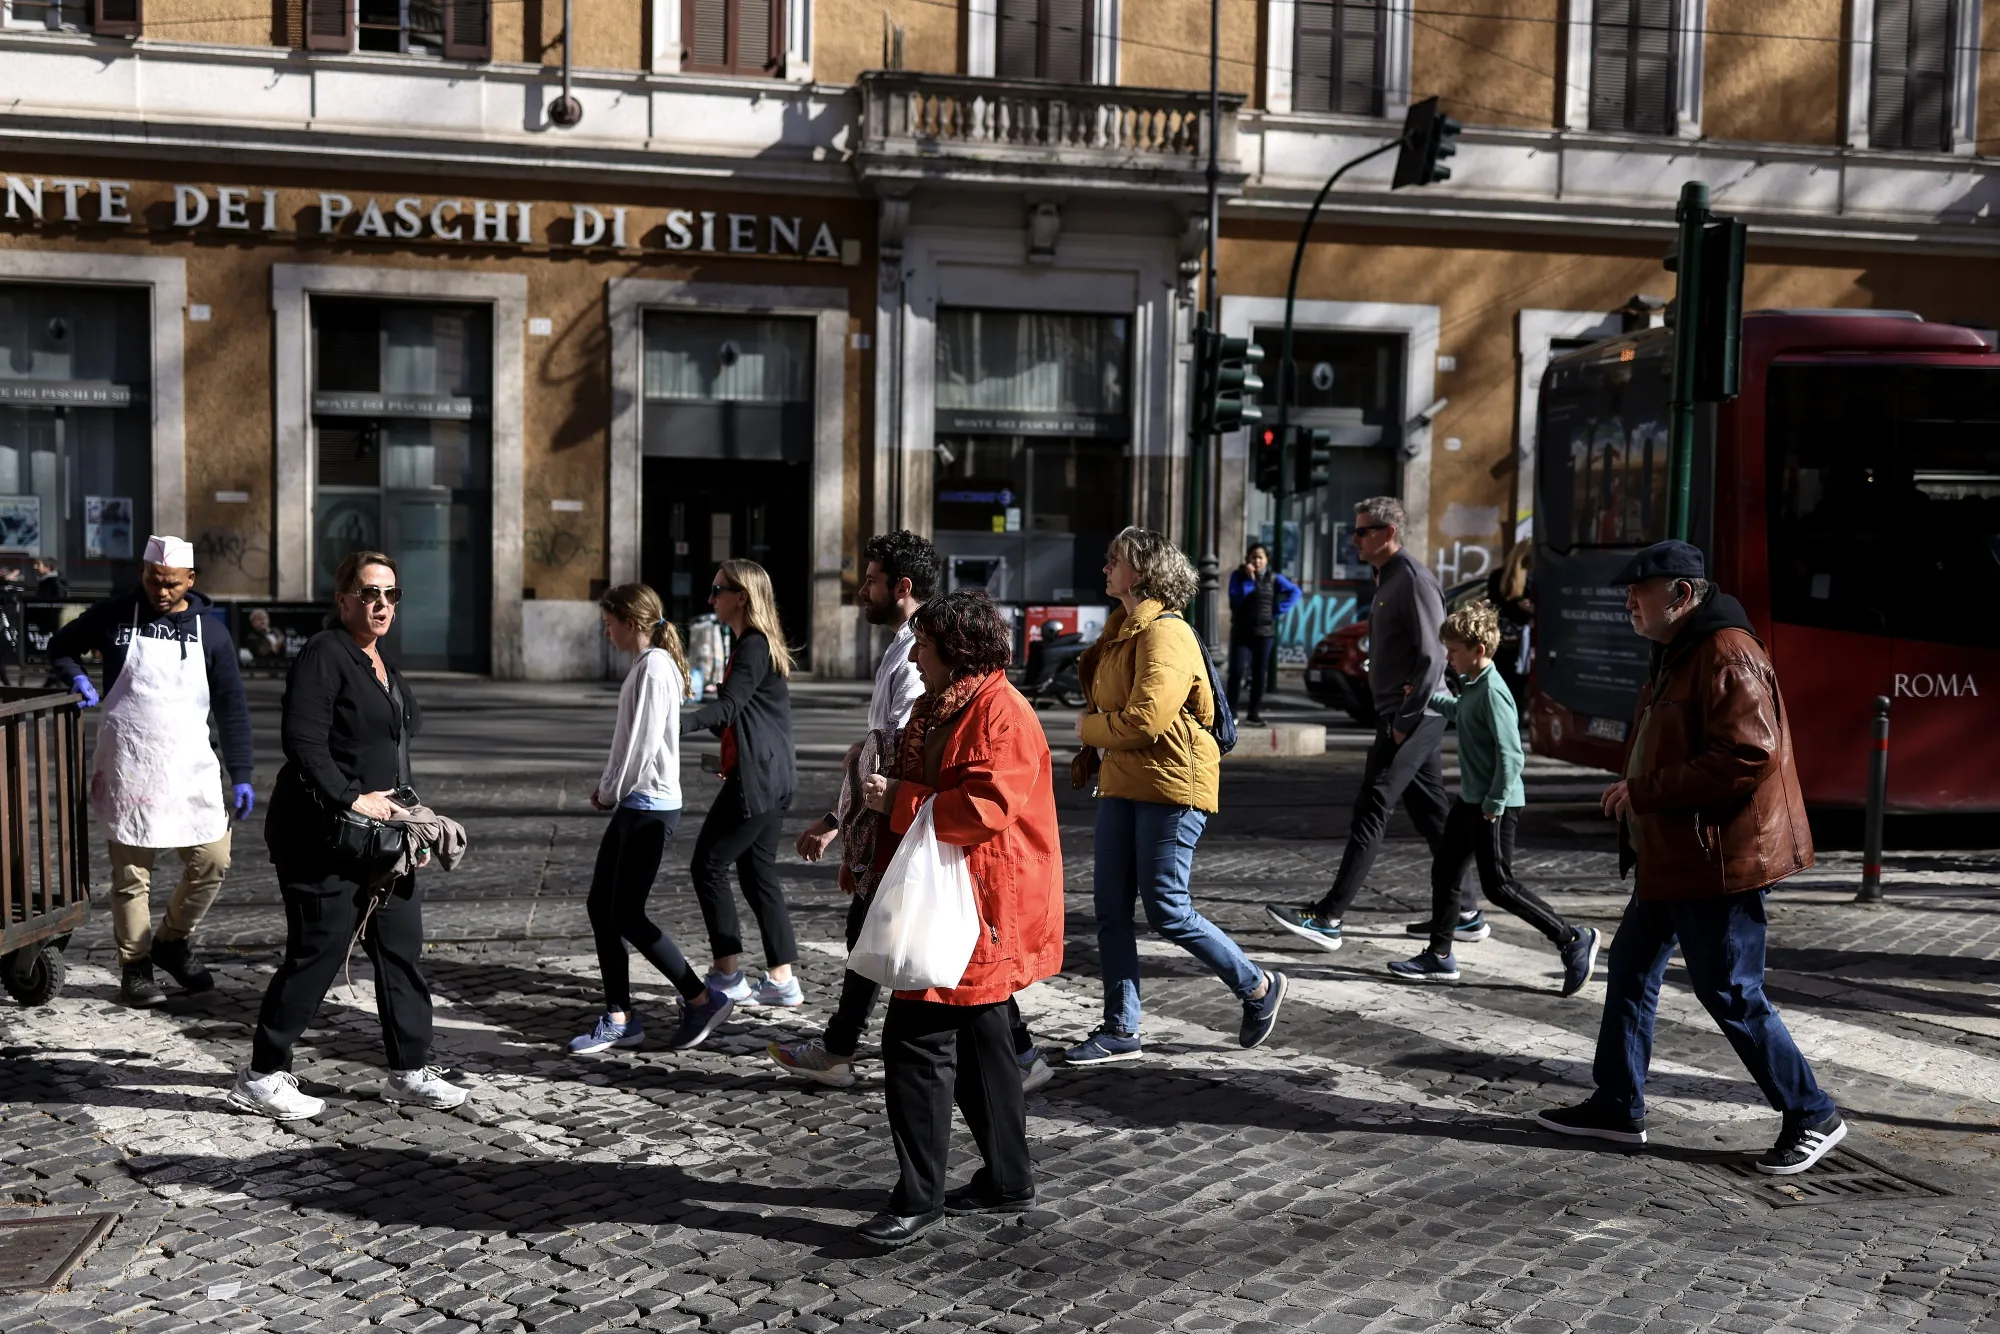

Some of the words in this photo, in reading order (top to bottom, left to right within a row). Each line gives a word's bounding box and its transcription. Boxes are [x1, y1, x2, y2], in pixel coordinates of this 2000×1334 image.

[172, 184, 279, 232] DEI
[318, 192, 533, 244] PASCHI
[571, 204, 629, 249] DI
[665, 210, 840, 258] SIENA
[14, 387, 37, 400] DEI
[41, 388, 89, 402] PASCHI
[93, 389, 107, 402] DI
[1893, 673, 1979, 698] ROMA
